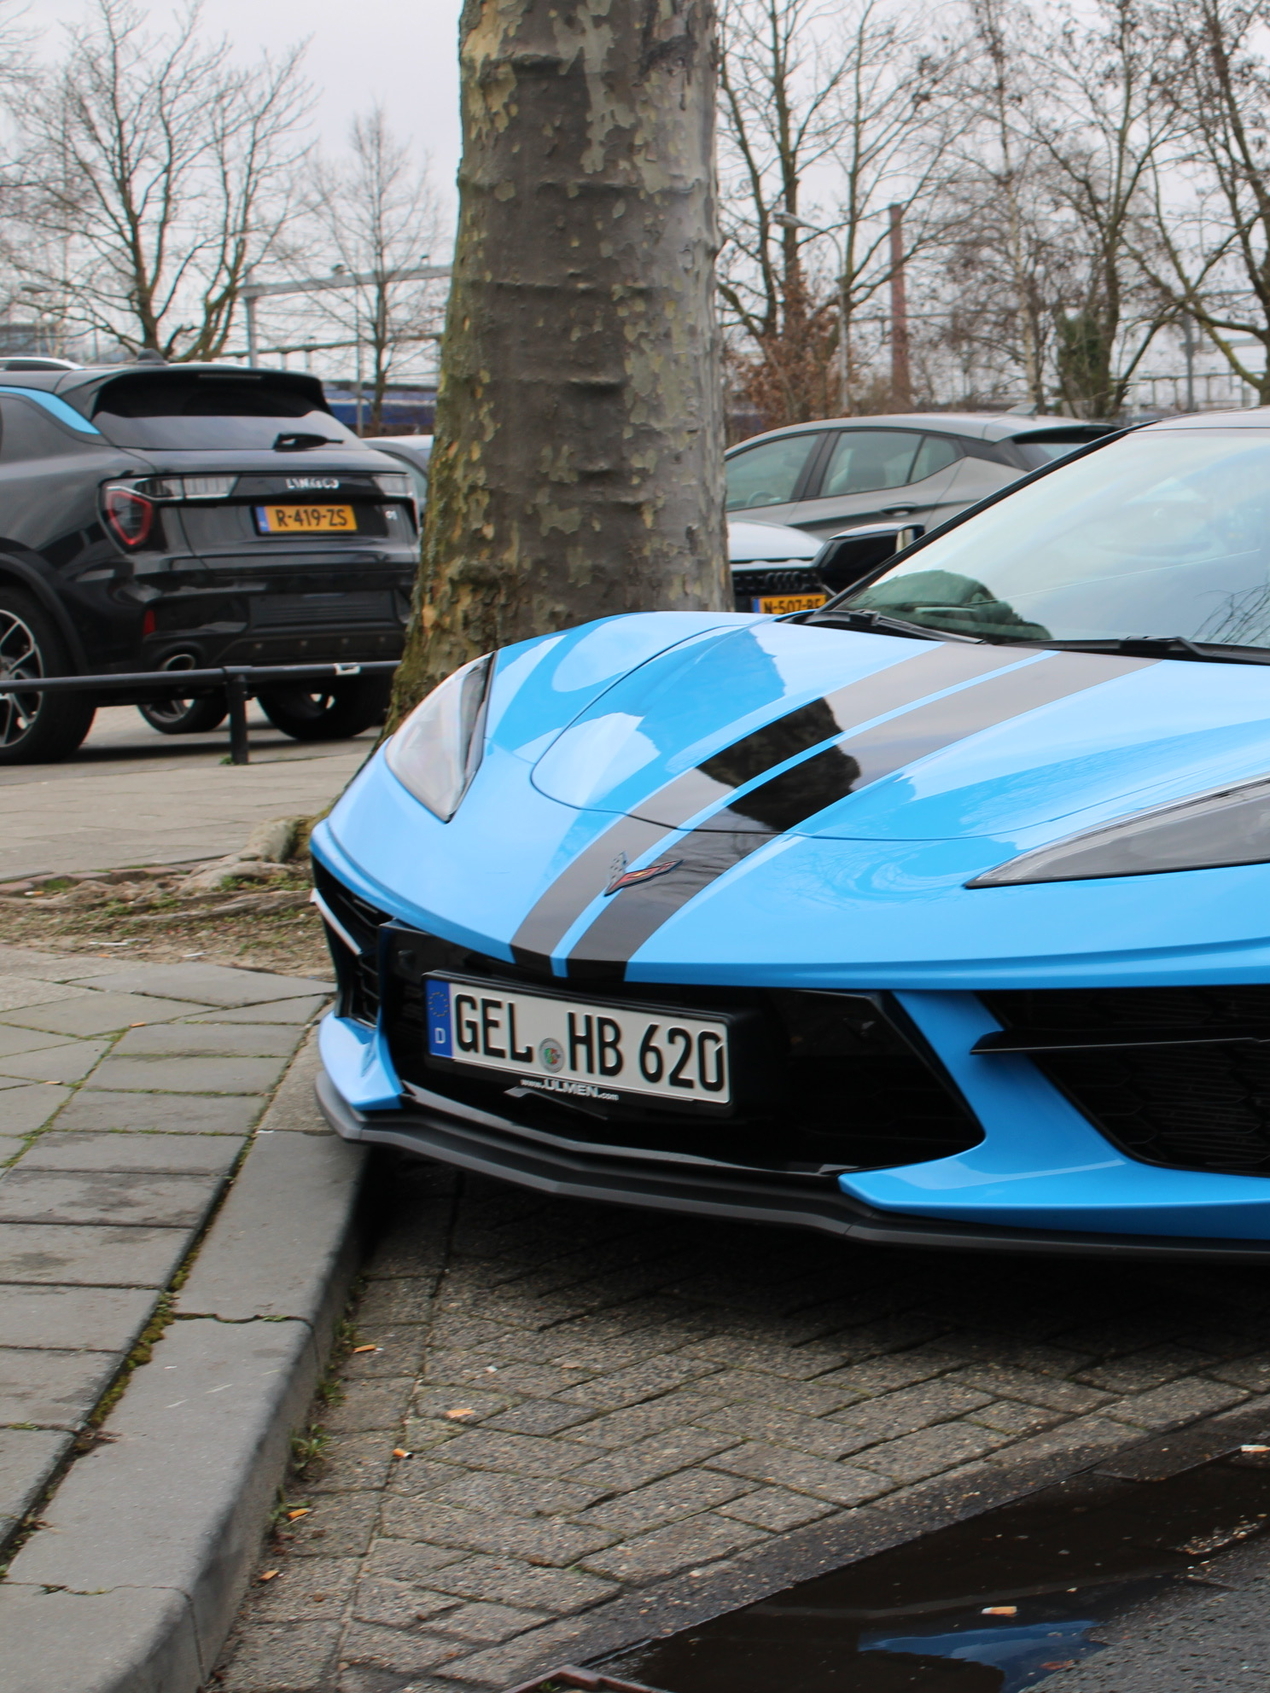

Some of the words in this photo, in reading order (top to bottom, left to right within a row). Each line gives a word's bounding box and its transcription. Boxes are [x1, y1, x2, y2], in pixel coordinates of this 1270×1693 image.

[275, 509, 348, 528] R-419-ZS
[434, 1027, 447, 1044] D
[455, 994, 534, 1063] GEL
[567, 1012, 623, 1077] HB
[639, 1023, 725, 1093] 620
